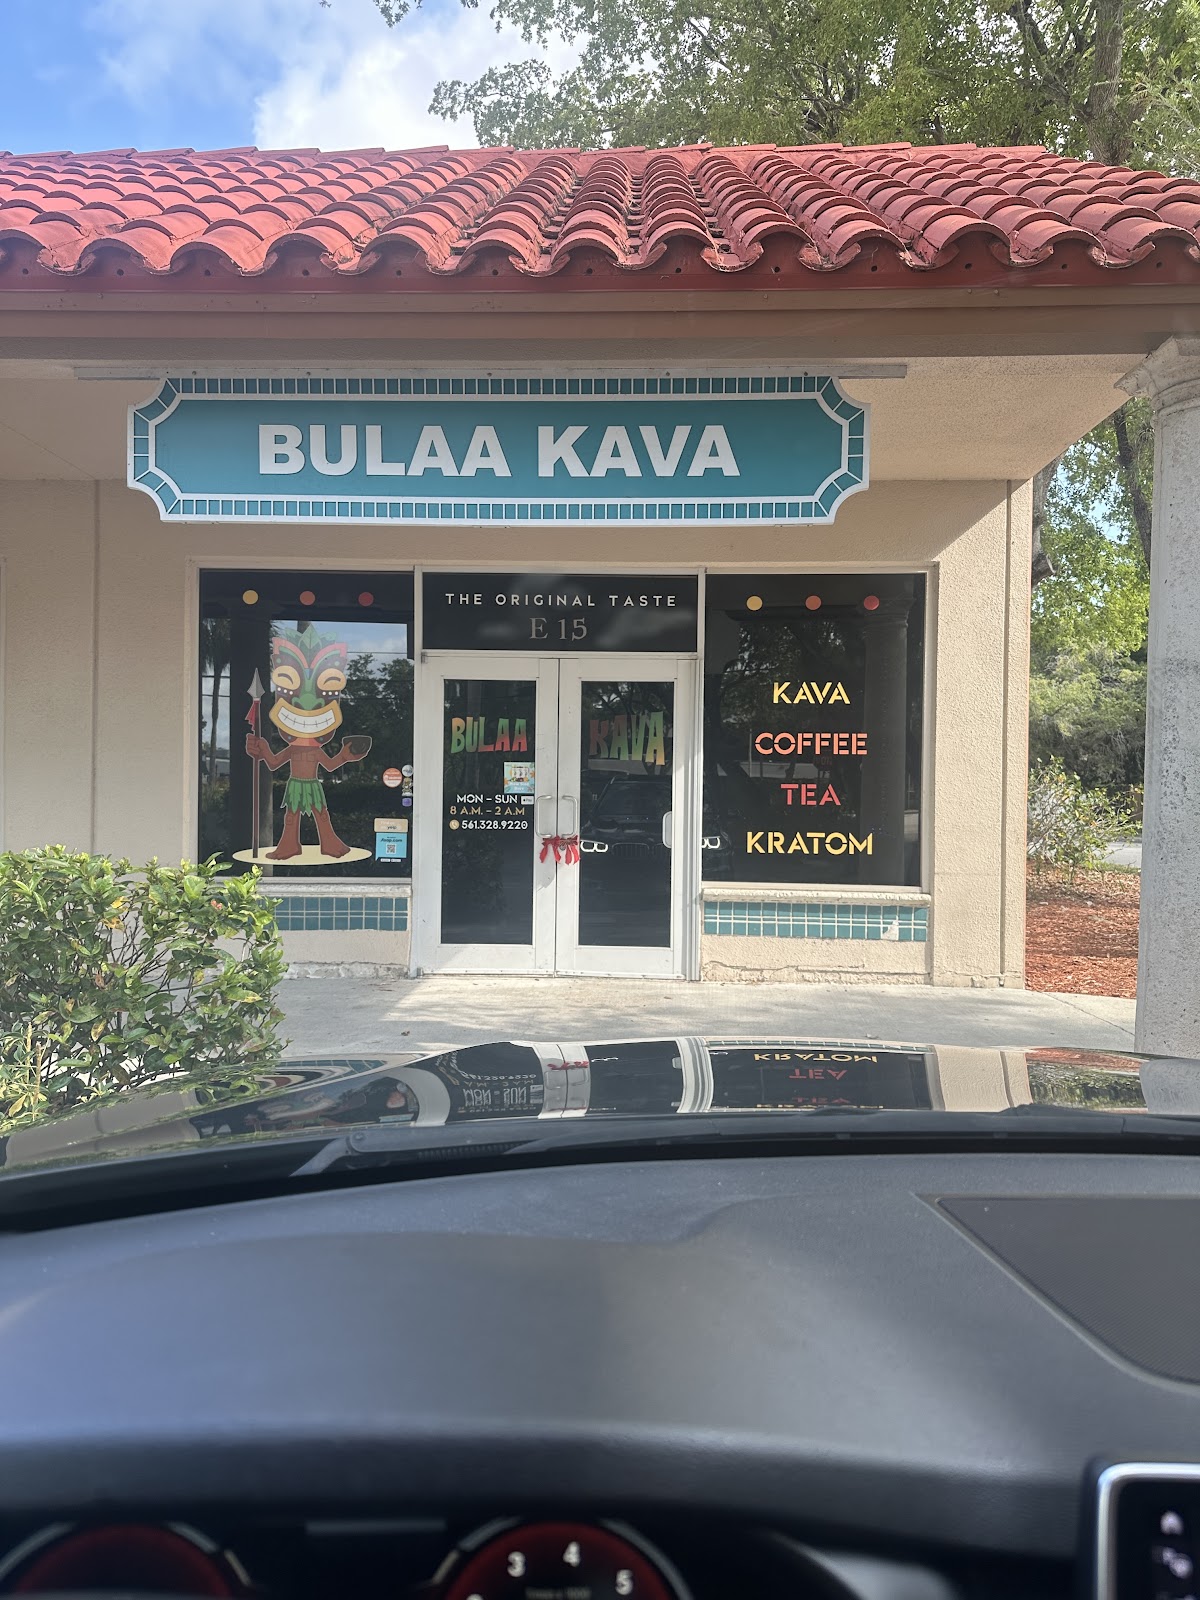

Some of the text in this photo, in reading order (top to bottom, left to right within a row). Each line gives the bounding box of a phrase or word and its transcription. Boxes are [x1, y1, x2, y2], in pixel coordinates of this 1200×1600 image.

[259, 425, 740, 478] BULAA KAVA
[445, 593, 677, 608] THE ORIGINAL TASTE
[529, 617, 588, 641] E 15
[773, 682, 850, 705] KAVA
[450, 711, 665, 766] BULAA KAVA
[755, 732, 868, 756] COFFEE
[456, 794, 484, 804] MON
[495, 794, 518, 804] SUN
[780, 783, 842, 806] TEA
[450, 806, 457, 815] 8
[460, 806, 483, 815] A.M.
[495, 806, 501, 815] 2
[461, 820, 528, 830] 561.328.9220
[746, 831, 873, 855] KRATOM
[507, 1551, 526, 1577] 3
[563, 1541, 581, 1567] 4
[615, 1569, 634, 1595] 5
